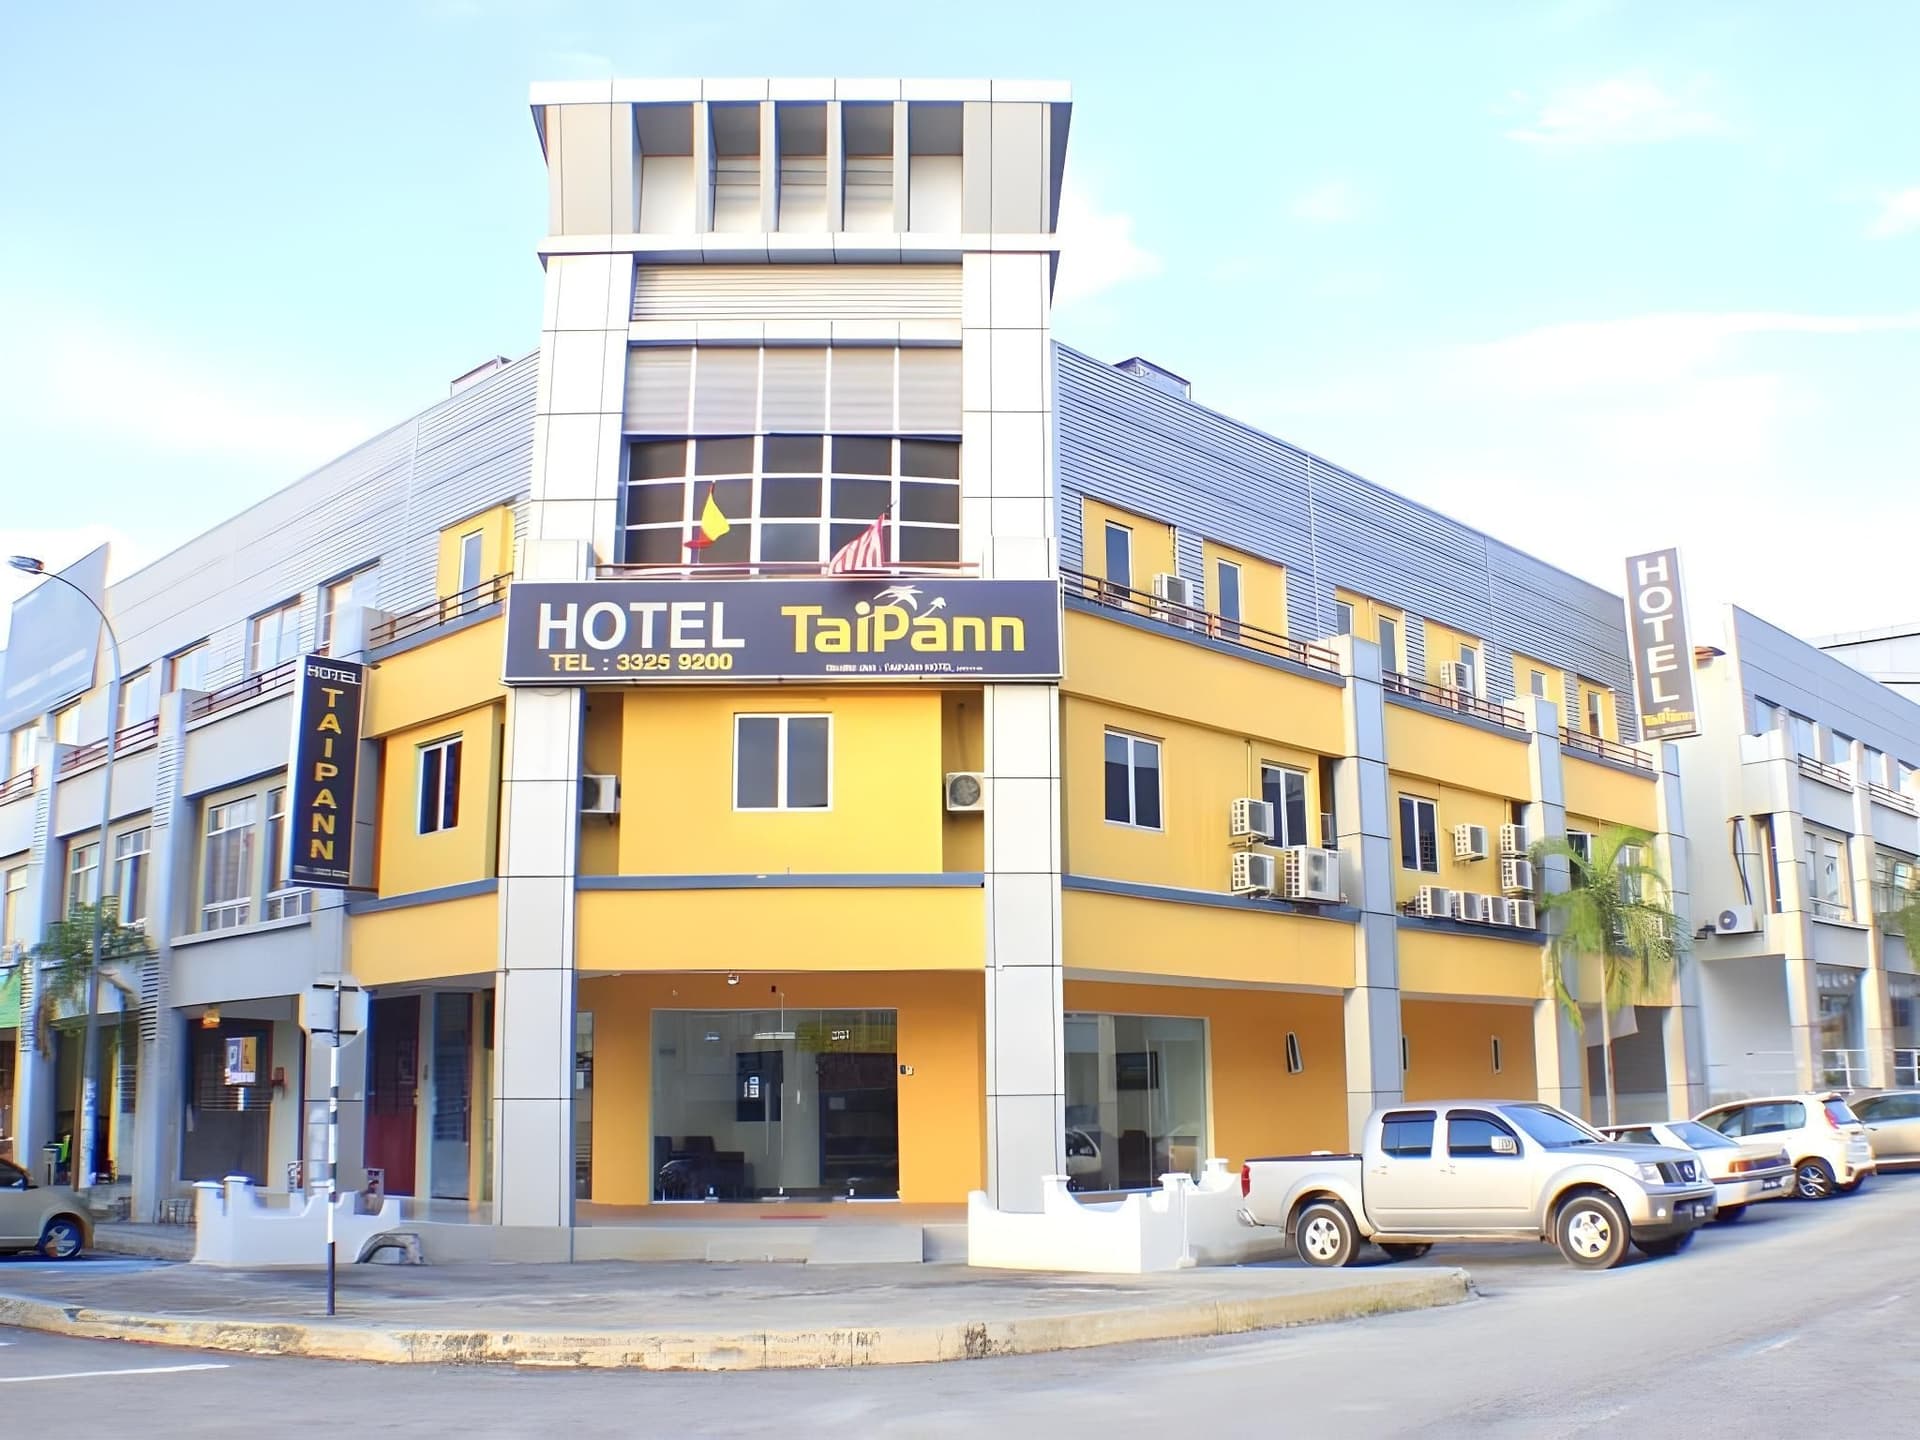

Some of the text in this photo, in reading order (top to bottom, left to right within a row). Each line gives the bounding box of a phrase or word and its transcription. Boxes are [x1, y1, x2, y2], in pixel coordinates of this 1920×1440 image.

[538, 601, 1025, 653] HOTEL TaiPann
[1637, 556, 1680, 703] HOTEL
[307, 664, 361, 685] HOTEL
[549, 654, 595, 671] TEL
[616, 653, 671, 671] 3325
[678, 653, 733, 671] 9200
[310, 687, 344, 861] TAIPANN
